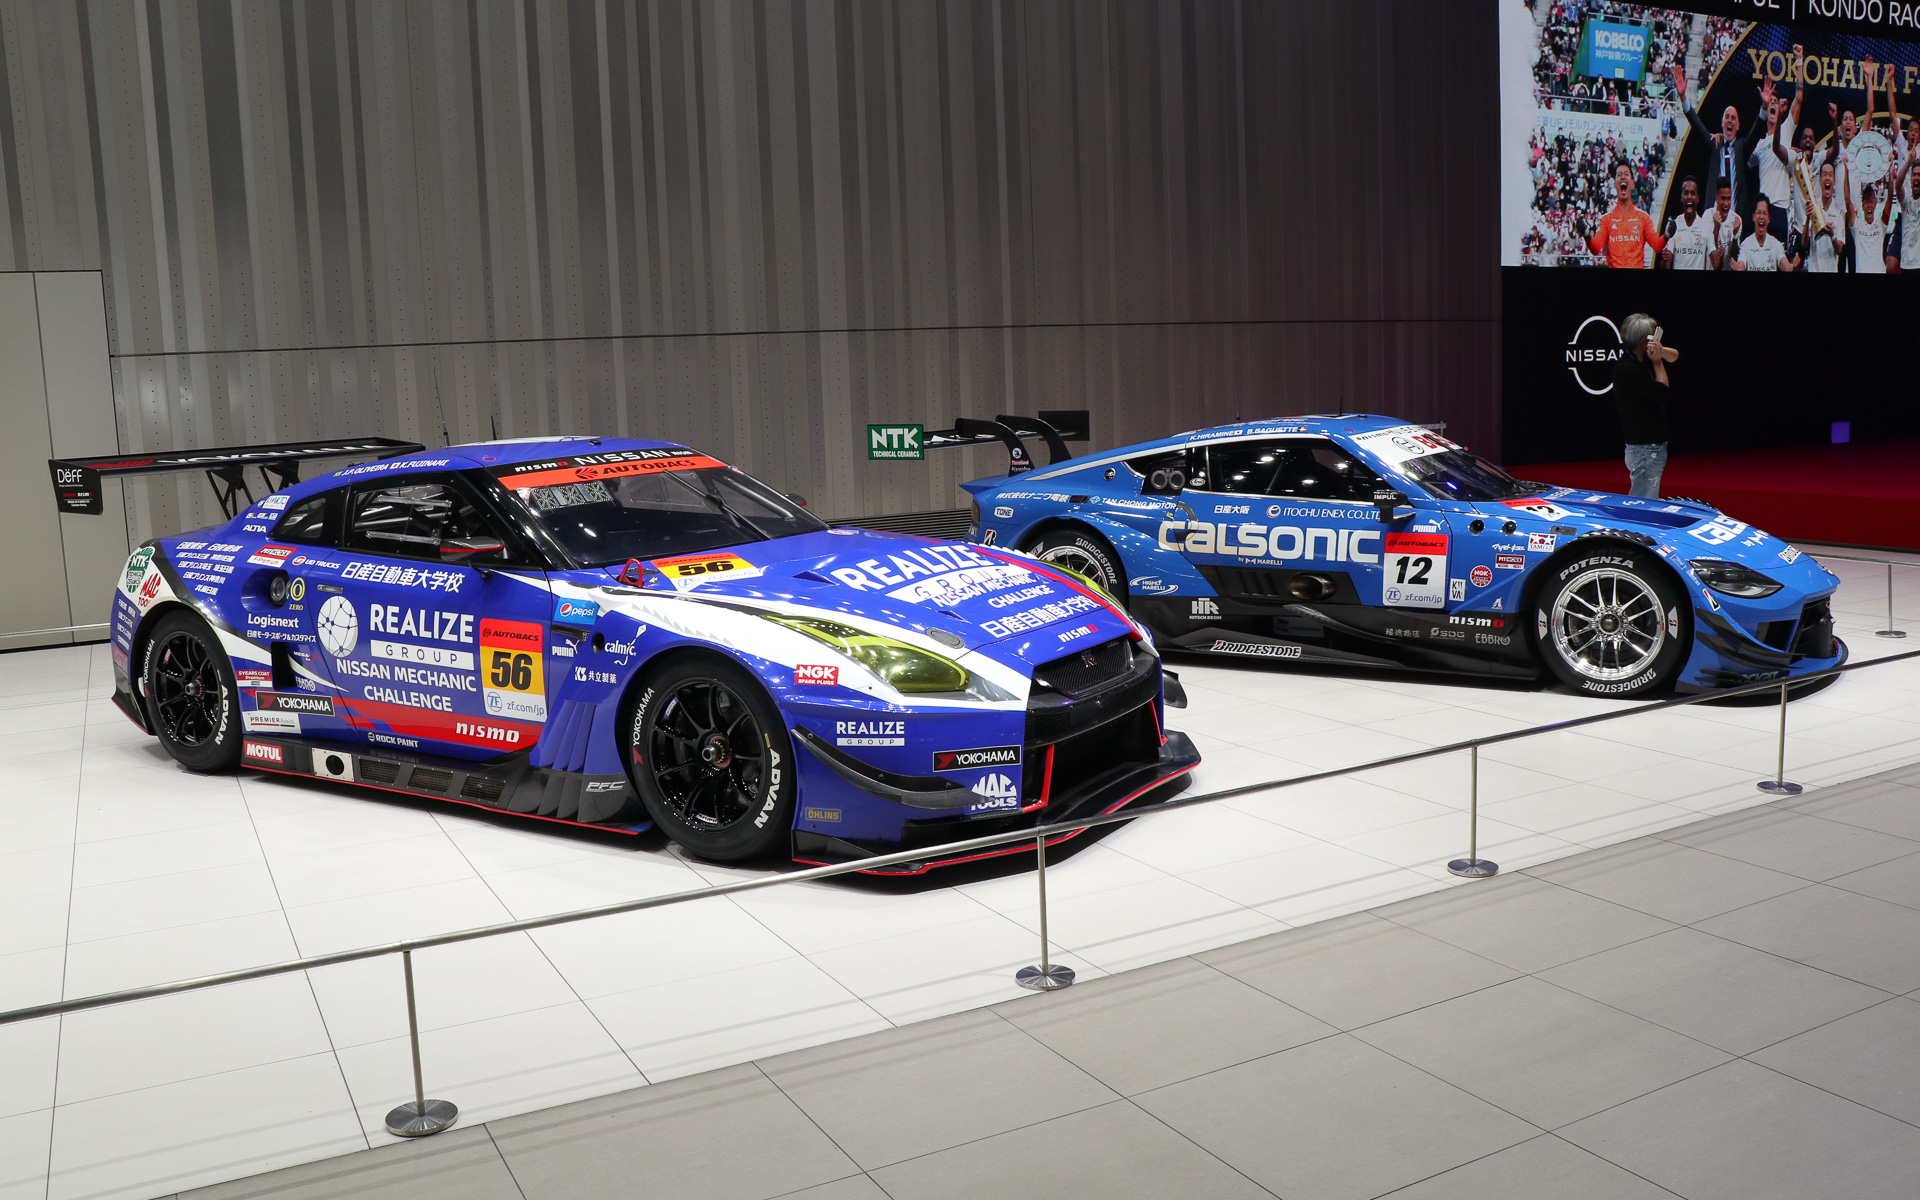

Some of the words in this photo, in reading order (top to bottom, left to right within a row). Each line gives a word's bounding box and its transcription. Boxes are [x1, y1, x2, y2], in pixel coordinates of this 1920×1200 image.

[1595, 29, 1645, 52] KOBELCO
[1674, 247, 1703, 255] NISSAN
[872, 428, 919, 449] NTK
[574, 450, 670, 465] NISSAN
[897, 450, 920, 458] CERAMICS
[603, 459, 695, 475] AUTOBACS
[57, 469, 82, 483] Dëff
[996, 508, 1012, 516] TONE
[1214, 505, 1250, 514] 日産大阪
[1284, 507, 1319, 517] ITOCHU
[1321, 508, 1345, 519] ENEX
[243, 525, 267, 533] ALTIA
[1398, 540, 1445, 548] AUTOBACS
[131, 555, 148, 568] NTK
[315, 561, 341, 569] TRUCKS
[678, 561, 734, 576] 56
[830, 545, 994, 592] REALIZE
[1076, 538, 1118, 584] BRIDGESTONE
[1560, 556, 1634, 580] POTENZA
[341, 561, 465, 593] 日産自動車大学校
[1396, 556, 1432, 585] 12
[932, 582, 989, 608] NISSAN
[985, 572, 1037, 596] MECHANIC
[988, 584, 1055, 608] CHALLENGE
[1404, 593, 1442, 604] zf.com/jp
[571, 606, 595, 617] pepsi
[980, 595, 1103, 639] 日産自動車大学校
[247, 613, 299, 628] Logisnext
[370, 603, 474, 644] REALIZE
[1449, 616, 1504, 628] nismo
[492, 631, 539, 642] AUTOBACS
[1058, 624, 1099, 643] nismo
[385, 644, 458, 665] GROUP
[1213, 640, 1301, 657] BRIDGESTONE
[144, 639, 155, 684] YOKOHAMA
[336, 659, 391, 681] NISSAN
[394, 665, 477, 692] MECHANIC
[491, 651, 532, 691] 56
[588, 671, 617, 684] 共立製薬
[797, 664, 836, 679] NGK
[1582, 668, 1657, 693] BRIDGESTONE
[276, 696, 331, 712] YOKOHAMA
[363, 685, 453, 712] CHALLENGE
[215, 684, 229, 745] ADVAN
[506, 701, 545, 716] zf.com/jp
[633, 687, 655, 746] YOKOHAMA
[456, 722, 520, 743] nismo
[836, 721, 905, 735] REALIZE
[376, 734, 396, 744] ROCK
[397, 737, 418, 748] PAINT
[847, 738, 895, 746] GROUP
[246, 743, 282, 761] MOTUL
[955, 749, 1016, 765] YOKOHAMA
[753, 748, 781, 829] ADVAN
[808, 808, 839, 821] ÖHLINS
